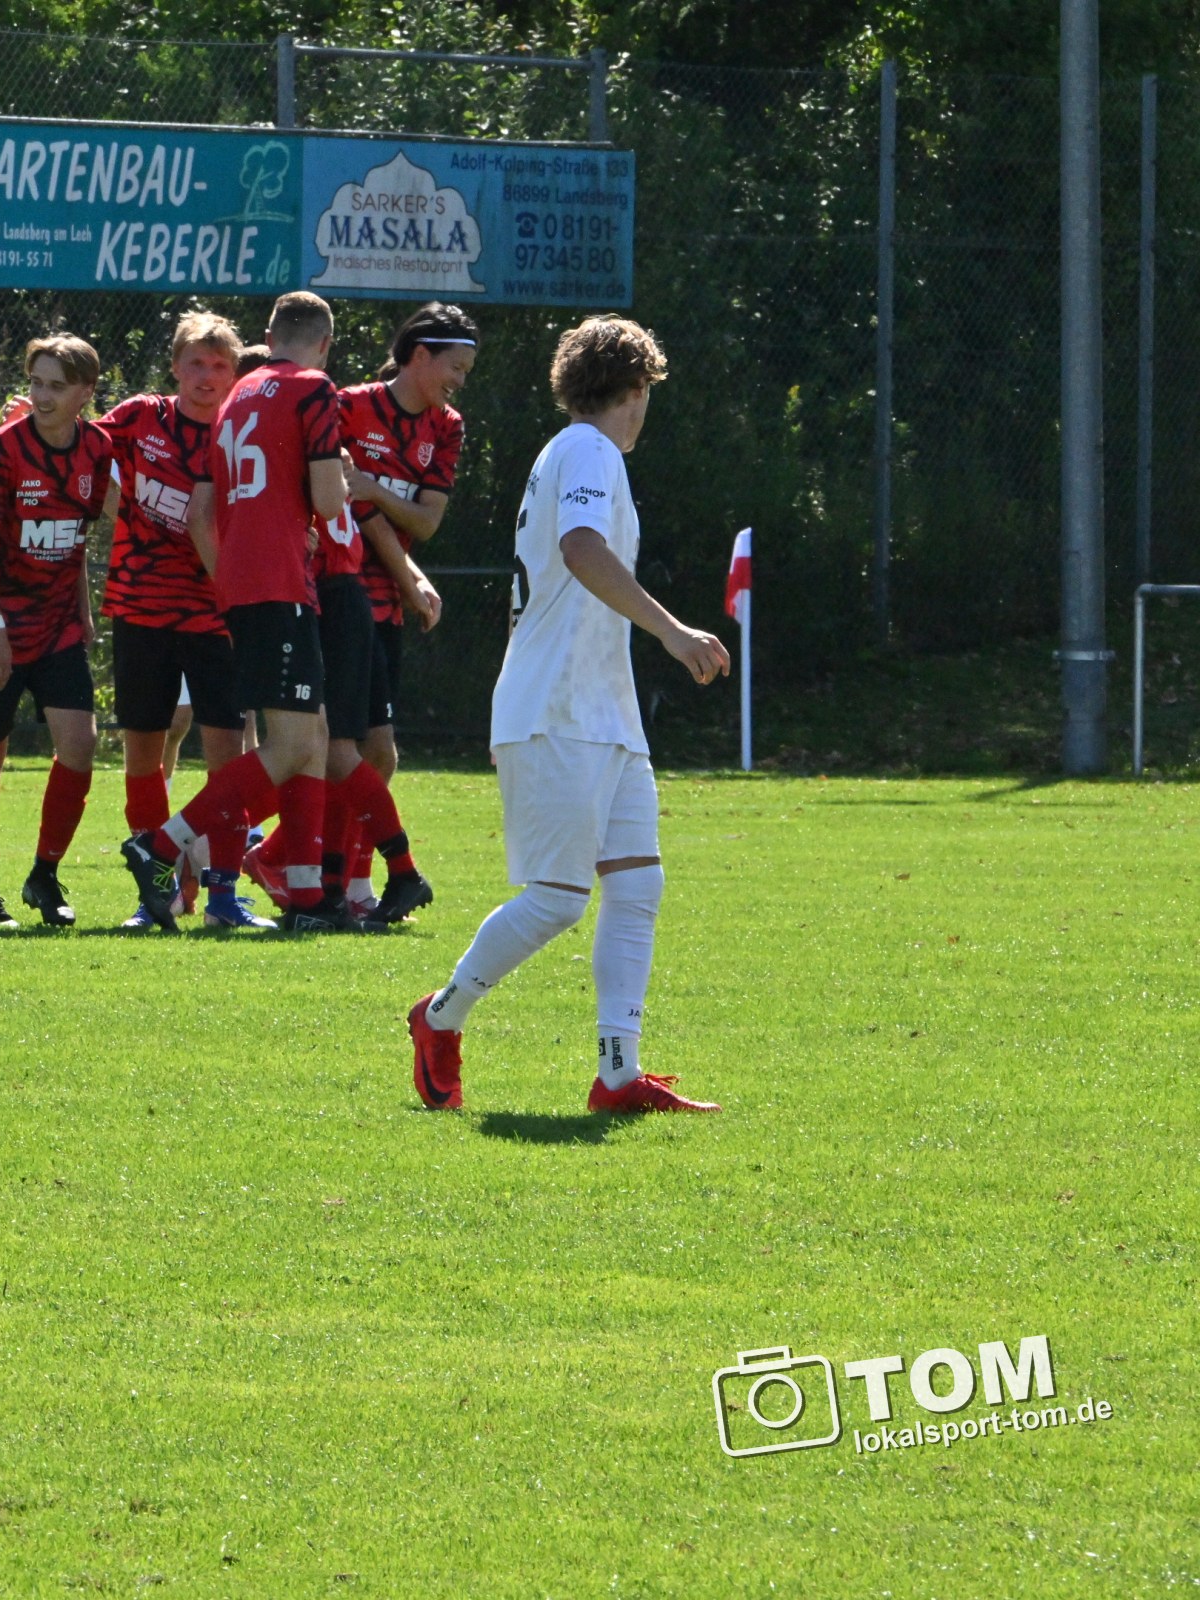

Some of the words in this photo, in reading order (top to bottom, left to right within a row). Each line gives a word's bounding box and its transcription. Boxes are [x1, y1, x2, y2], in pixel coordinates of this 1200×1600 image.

[450, 151, 599, 177] Adolf-Kolping-Straße
[503, 184, 550, 202] 86899
[557, 188, 628, 210] Landsberg
[3, 222, 50, 246] Landsberg
[54, 229, 67, 241] am
[70, 224, 92, 242] Lech
[328, 214, 470, 253] MASALA
[333, 254, 391, 271] Indisches
[395, 256, 463, 274] Restaurant
[146, 434, 166, 447] JAKO
[366, 431, 385, 442] JAKO
[216, 411, 267, 505] 16
[366, 450, 381, 460] PIO
[23, 498, 38, 506] PIO
[294, 683, 311, 700] 16
